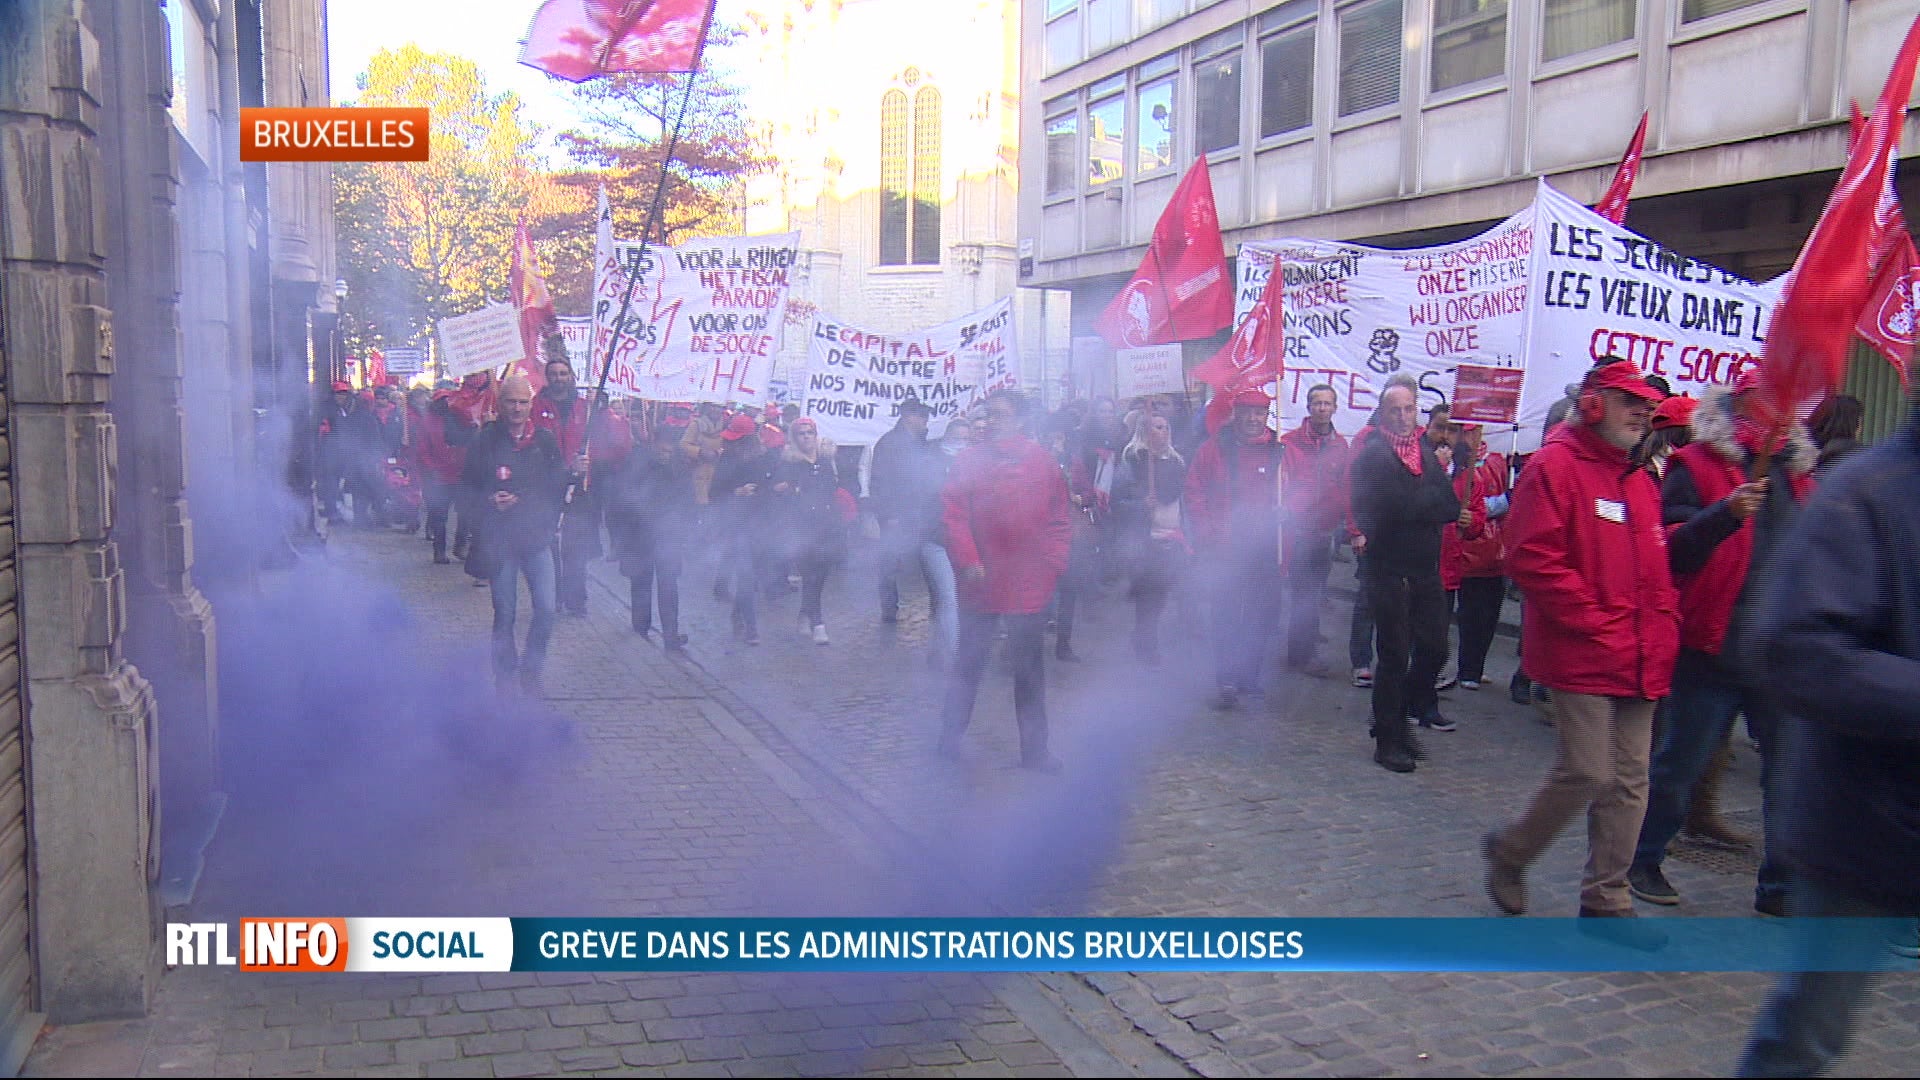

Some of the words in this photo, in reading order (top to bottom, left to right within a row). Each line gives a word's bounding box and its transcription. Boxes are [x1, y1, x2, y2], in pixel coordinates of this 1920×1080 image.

[1550, 222, 1603, 262] LES
[1417, 268, 1468, 297] ONZE
[1544, 270, 1592, 309] LES
[1679, 292, 1744, 337] DANS
[1751, 304, 1768, 342] L
[815, 321, 837, 342] LE
[839, 328, 948, 360] CAPITAL
[1425, 324, 1480, 357] ONZE
[1589, 328, 1674, 376] CETTE
[810, 373, 845, 392] NOS
[987, 354, 1006, 379] SE
[827, 348, 857, 368] DE
[869, 356, 937, 379] NOTRE
[806, 398, 879, 421] FOUTENT
